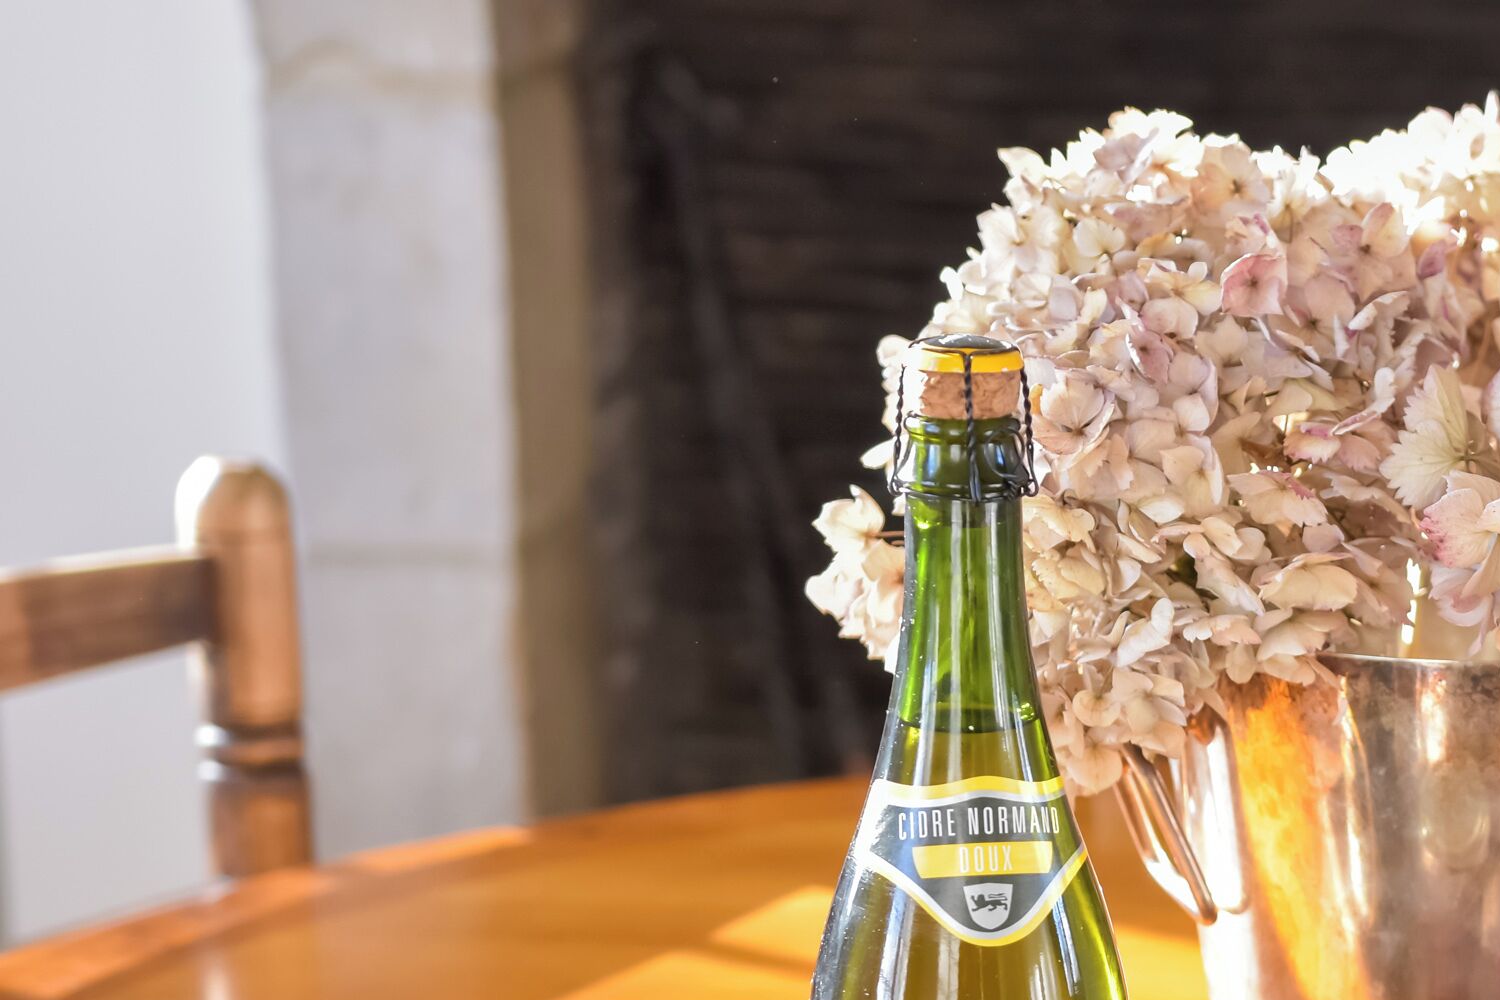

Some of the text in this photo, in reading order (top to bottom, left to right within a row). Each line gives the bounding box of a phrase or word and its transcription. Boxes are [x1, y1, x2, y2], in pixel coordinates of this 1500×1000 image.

[898, 805, 1060, 841] CIDRE NORMAND
[958, 845, 1013, 873] DOUX
